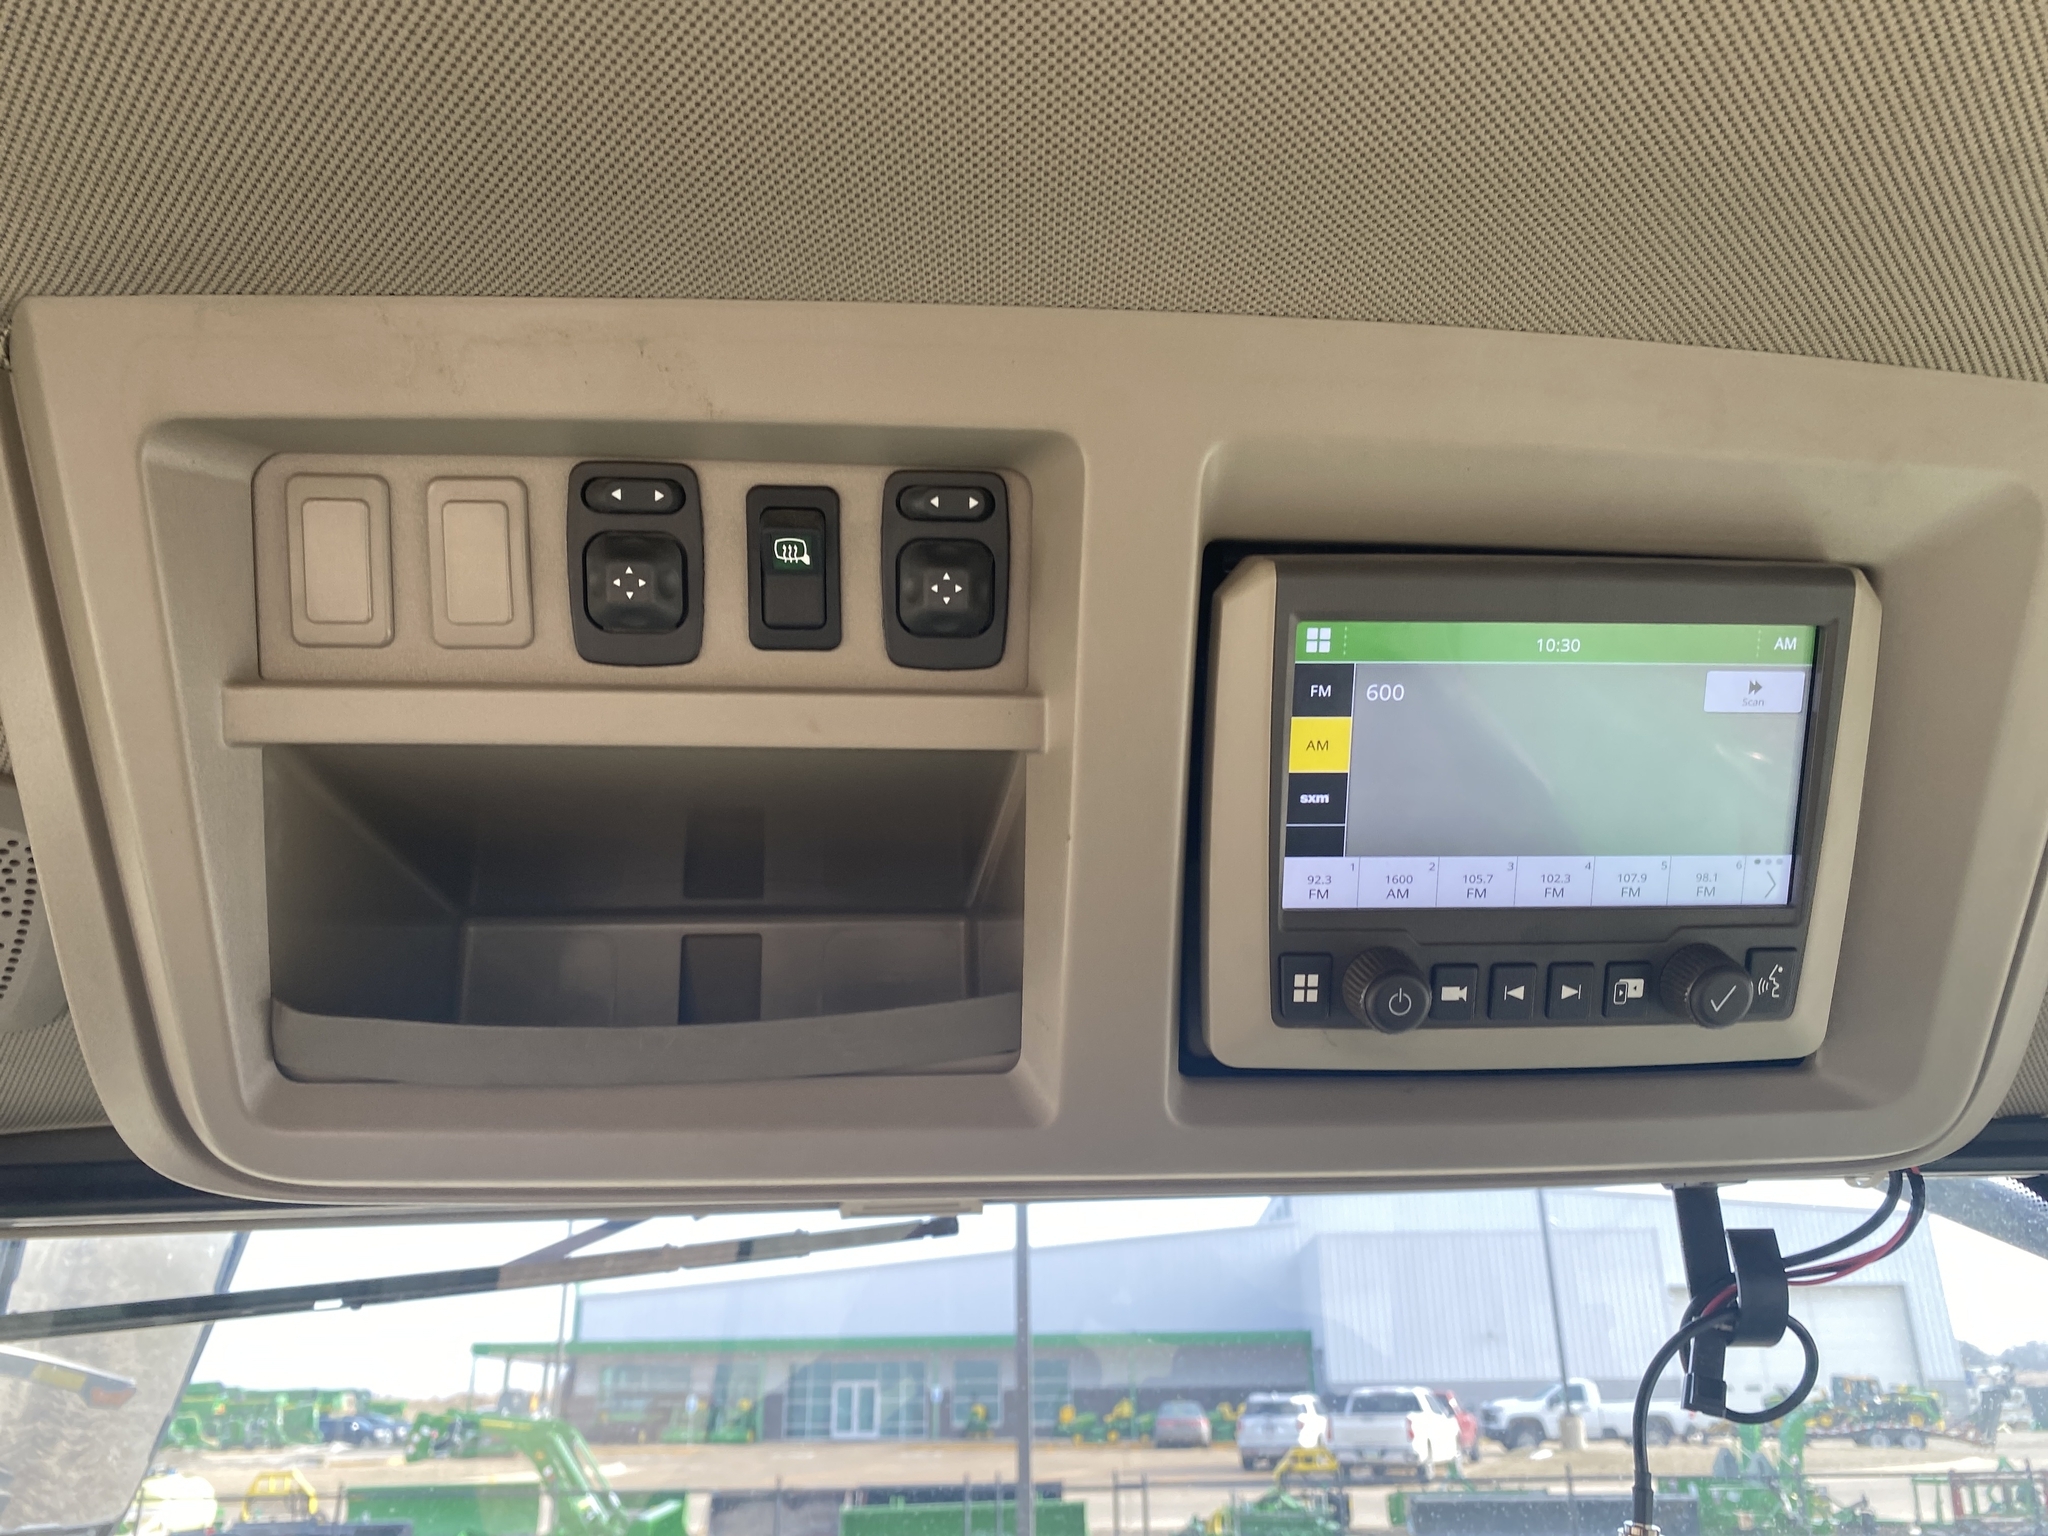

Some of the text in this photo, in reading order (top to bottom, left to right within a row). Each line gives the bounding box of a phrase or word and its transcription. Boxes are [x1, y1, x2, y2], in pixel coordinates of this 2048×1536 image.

[1536, 638, 1581, 653] 10:30
[1774, 637, 1798, 651] AM
[1310, 684, 1332, 698] FM
[1366, 683, 1405, 701] 600
[1742, 697, 1765, 707] Scan
[1305, 740, 1329, 751] AM
[1300, 793, 1330, 804] sxm
[1350, 862, 1355, 872] 1
[1428, 862, 1436, 872] 2
[1507, 861, 1514, 871] 3
[1584, 861, 1591, 870] 4
[1661, 860, 1668, 870] 5
[1736, 860, 1742, 870] 6
[1307, 875, 1332, 885] 92.3
[1386, 874, 1414, 884] 1600
[1463, 874, 1494, 884] 105.7
[1541, 873, 1571, 884] 102.3
[1618, 873, 1647, 883] 107.9
[1695, 872, 1718, 883] 98.1
[1308, 888, 1329, 900] FM
[1386, 888, 1410, 899] AM
[1466, 887, 1487, 899] FM
[1544, 887, 1564, 898] FM
[1621, 886, 1641, 898] FM
[1696, 886, 1716, 897] FM
